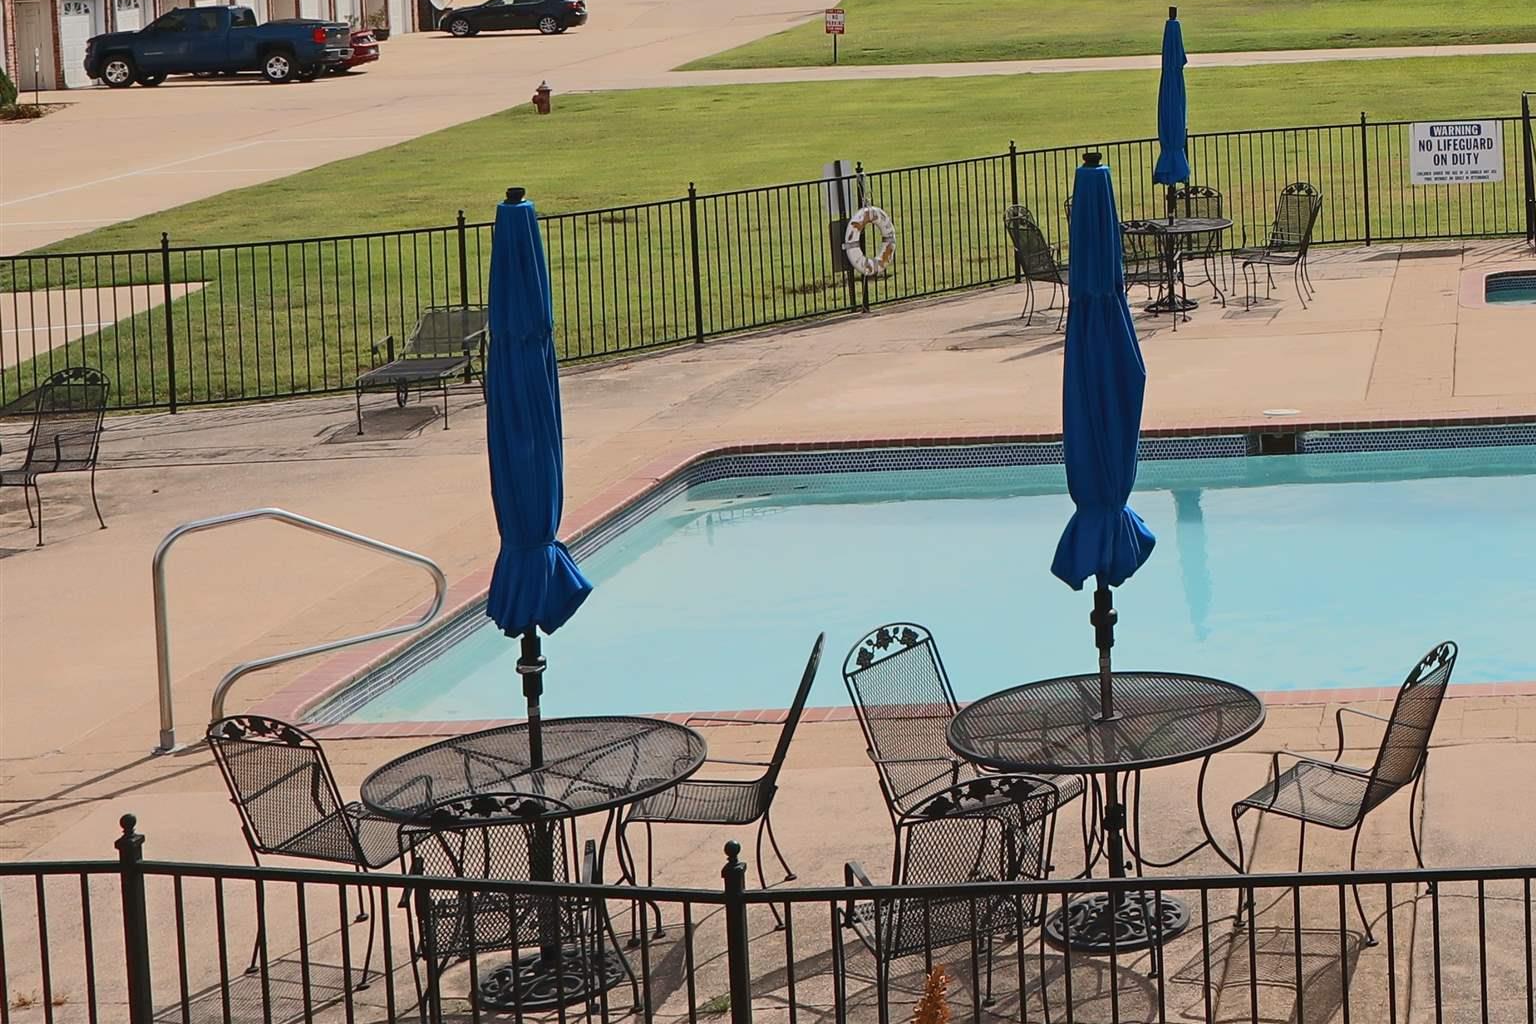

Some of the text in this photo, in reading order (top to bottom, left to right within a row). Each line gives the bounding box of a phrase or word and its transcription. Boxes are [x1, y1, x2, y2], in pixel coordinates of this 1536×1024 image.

[1432, 124, 1479, 136] WARNING
[1418, 137, 1494, 152] NO LIFEGUARD
[1433, 152, 1480, 166] ON DUTY
